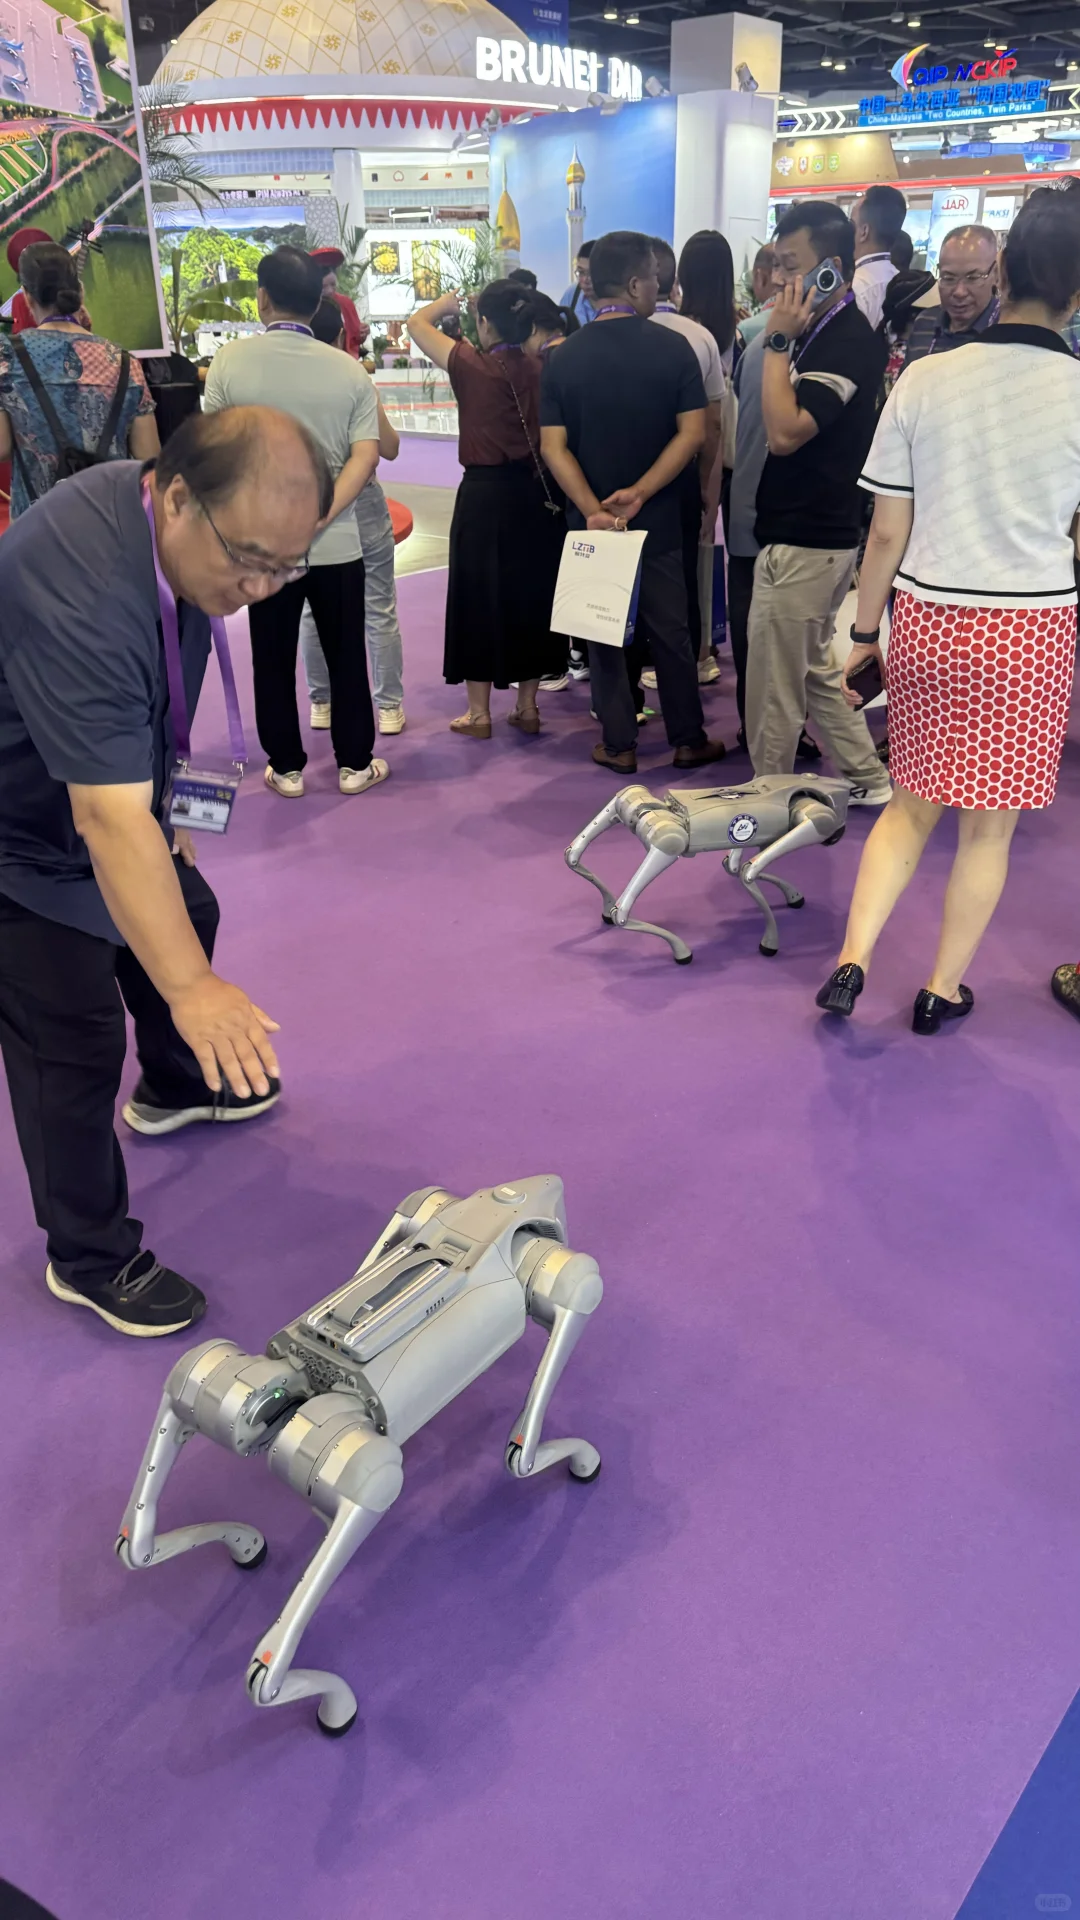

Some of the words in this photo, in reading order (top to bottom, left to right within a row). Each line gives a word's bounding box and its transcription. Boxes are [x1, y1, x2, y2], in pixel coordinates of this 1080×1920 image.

[476, 37, 598, 92] BRUNEI
[868, 112, 923, 125] China-Malaysia
[945, 107, 985, 118] Countries,
[987, 103, 1007, 114] Twin
